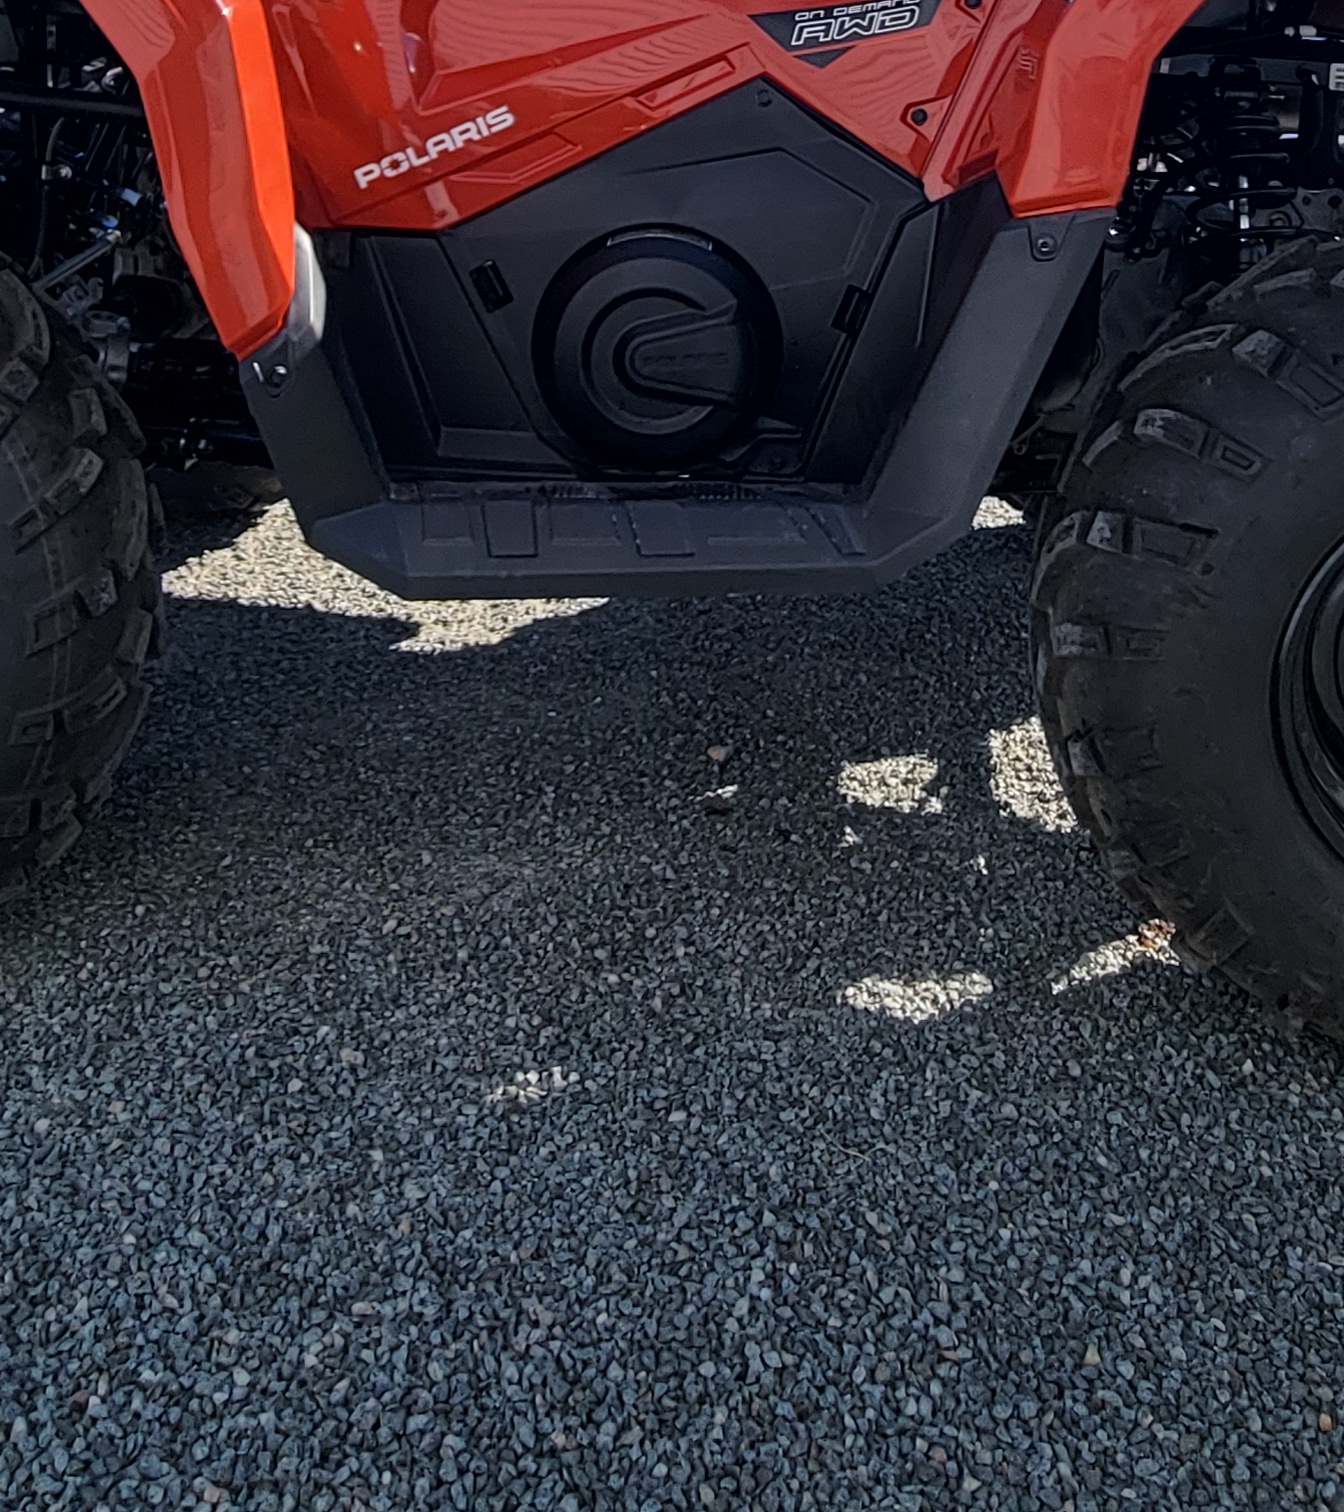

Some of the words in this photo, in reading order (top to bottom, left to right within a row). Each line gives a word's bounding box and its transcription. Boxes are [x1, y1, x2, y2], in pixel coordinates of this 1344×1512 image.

[790, 5, 920, 46] AWD
[794, 9, 826, 22] ON
[353, 105, 516, 190] POLARIS
